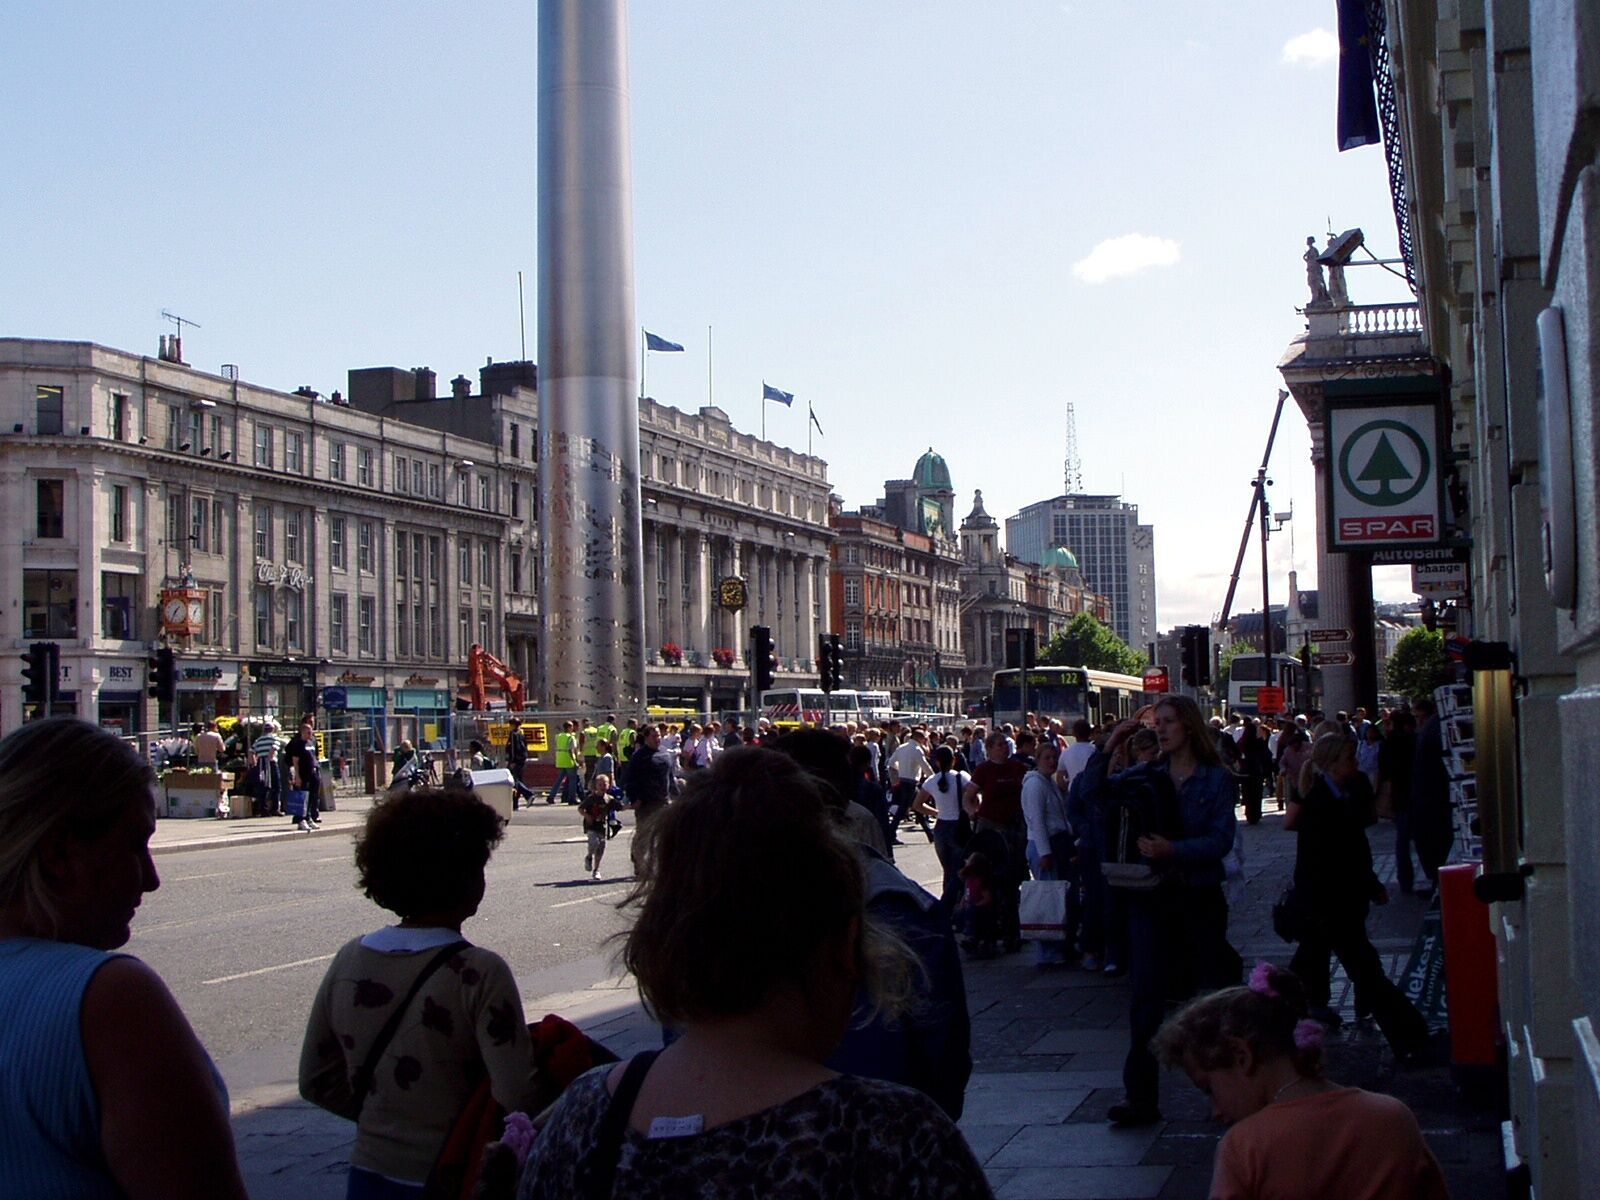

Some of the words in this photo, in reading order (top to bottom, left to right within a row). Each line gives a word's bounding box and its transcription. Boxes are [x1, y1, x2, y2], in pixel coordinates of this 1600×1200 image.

[1343, 520, 1433, 537] SPAR
[1138, 563, 1149, 649] Heineke
[109, 666, 133, 678] BEST
[1060, 672, 1078, 684] 122
